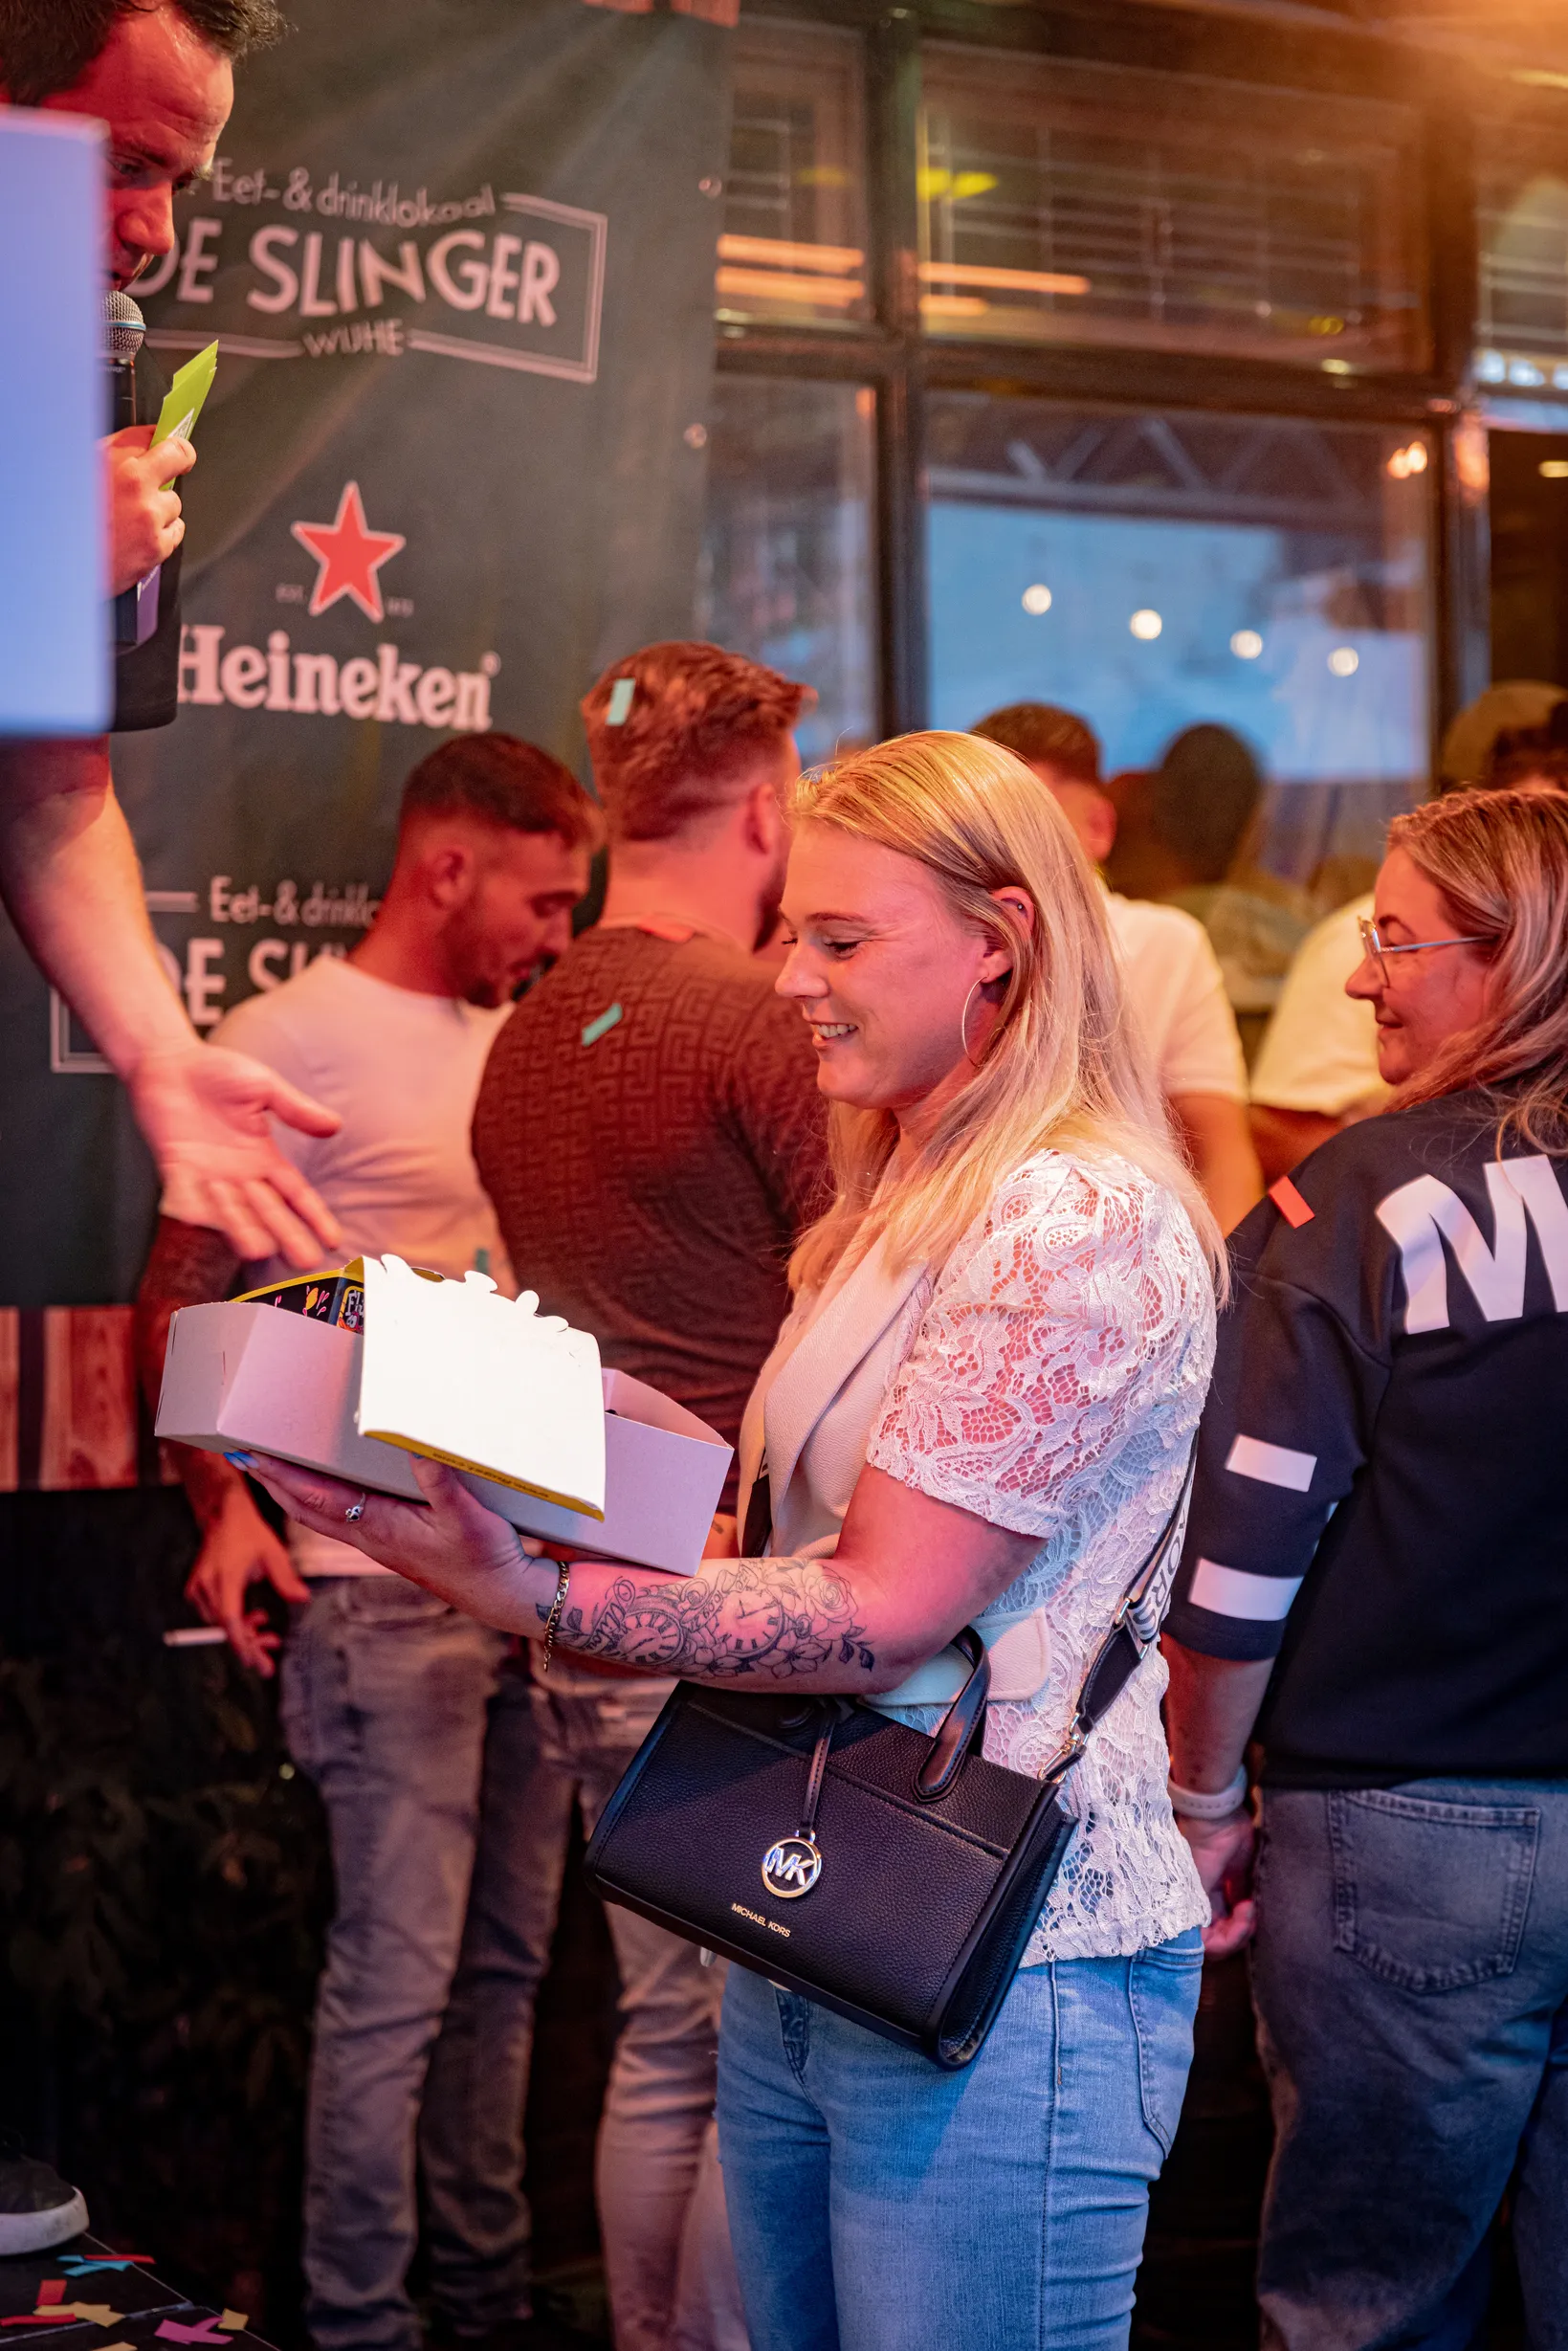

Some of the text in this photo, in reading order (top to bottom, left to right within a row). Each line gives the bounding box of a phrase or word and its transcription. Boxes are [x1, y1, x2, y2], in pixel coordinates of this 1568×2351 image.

[211, 156, 497, 229] Eet- & drinklokaal
[246, 224, 561, 327] SLINGER
[177, 623, 492, 733] Heineken
[273, 878, 300, 926] &
[764, 1846, 815, 1886] MK
[731, 1902, 791, 1938] MICHAEL KORS
